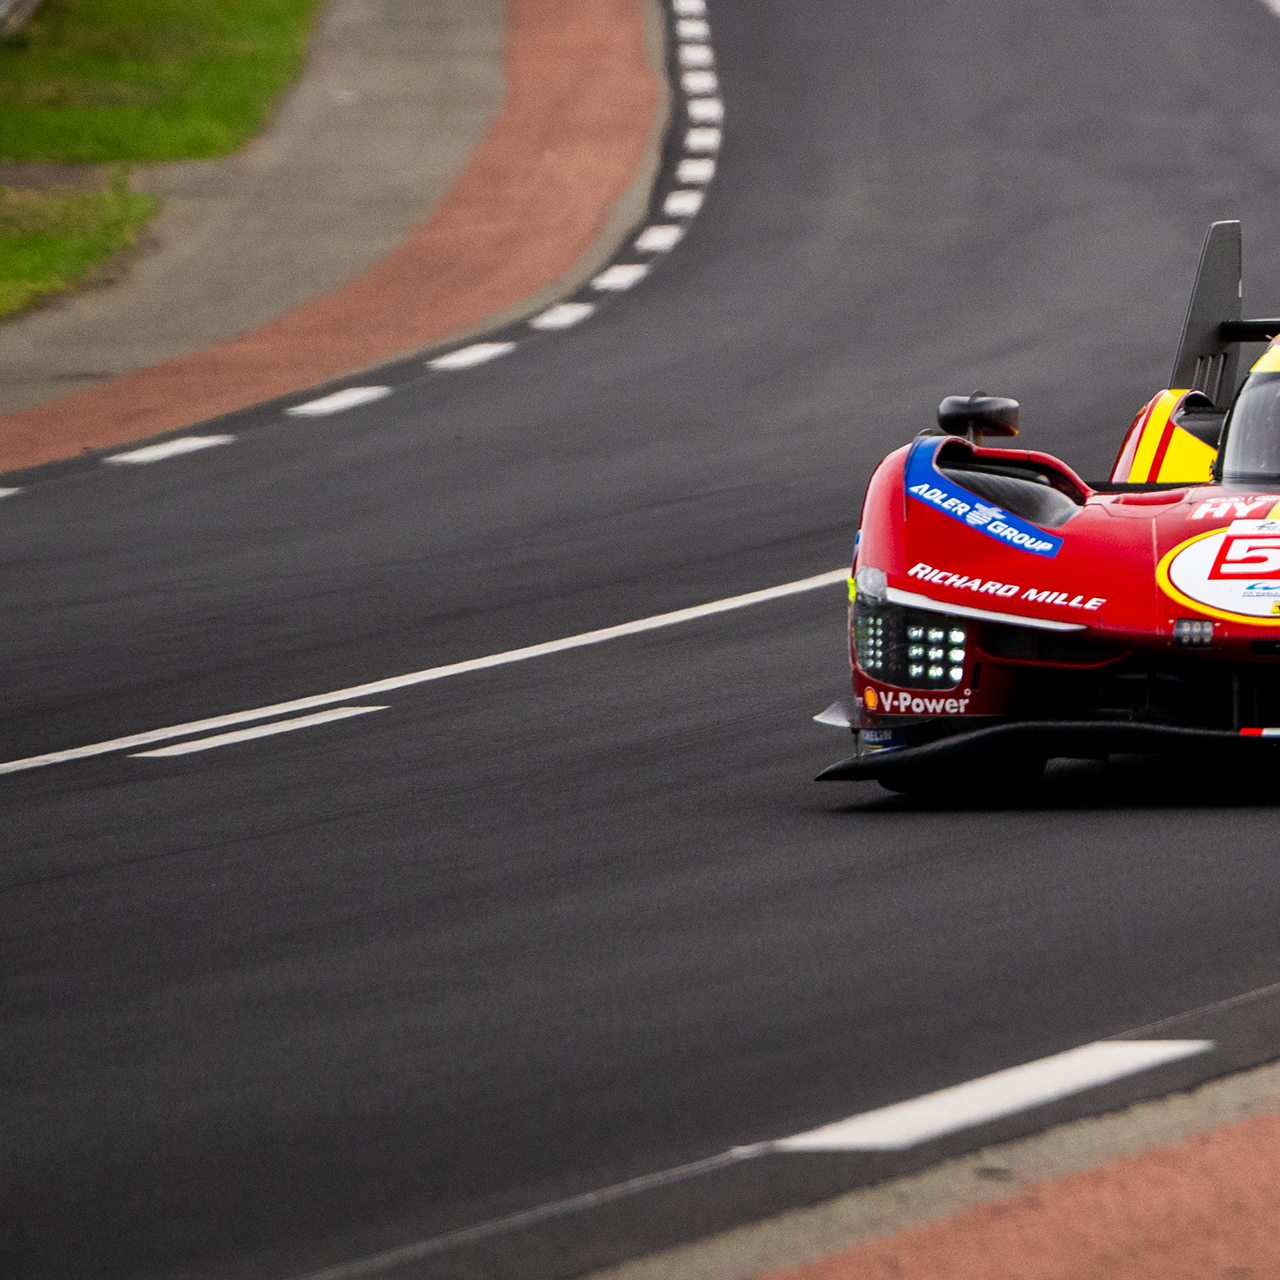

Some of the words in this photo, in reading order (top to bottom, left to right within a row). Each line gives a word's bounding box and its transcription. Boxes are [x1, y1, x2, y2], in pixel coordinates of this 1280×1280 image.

[909, 483, 971, 516] ADLER
[987, 521, 1053, 552] GROUP
[1192, 501, 1266, 519] HY
[907, 563, 1020, 598] RICHARD
[1021, 588, 1107, 611] MILLE
[879, 691, 970, 713] V-Power
